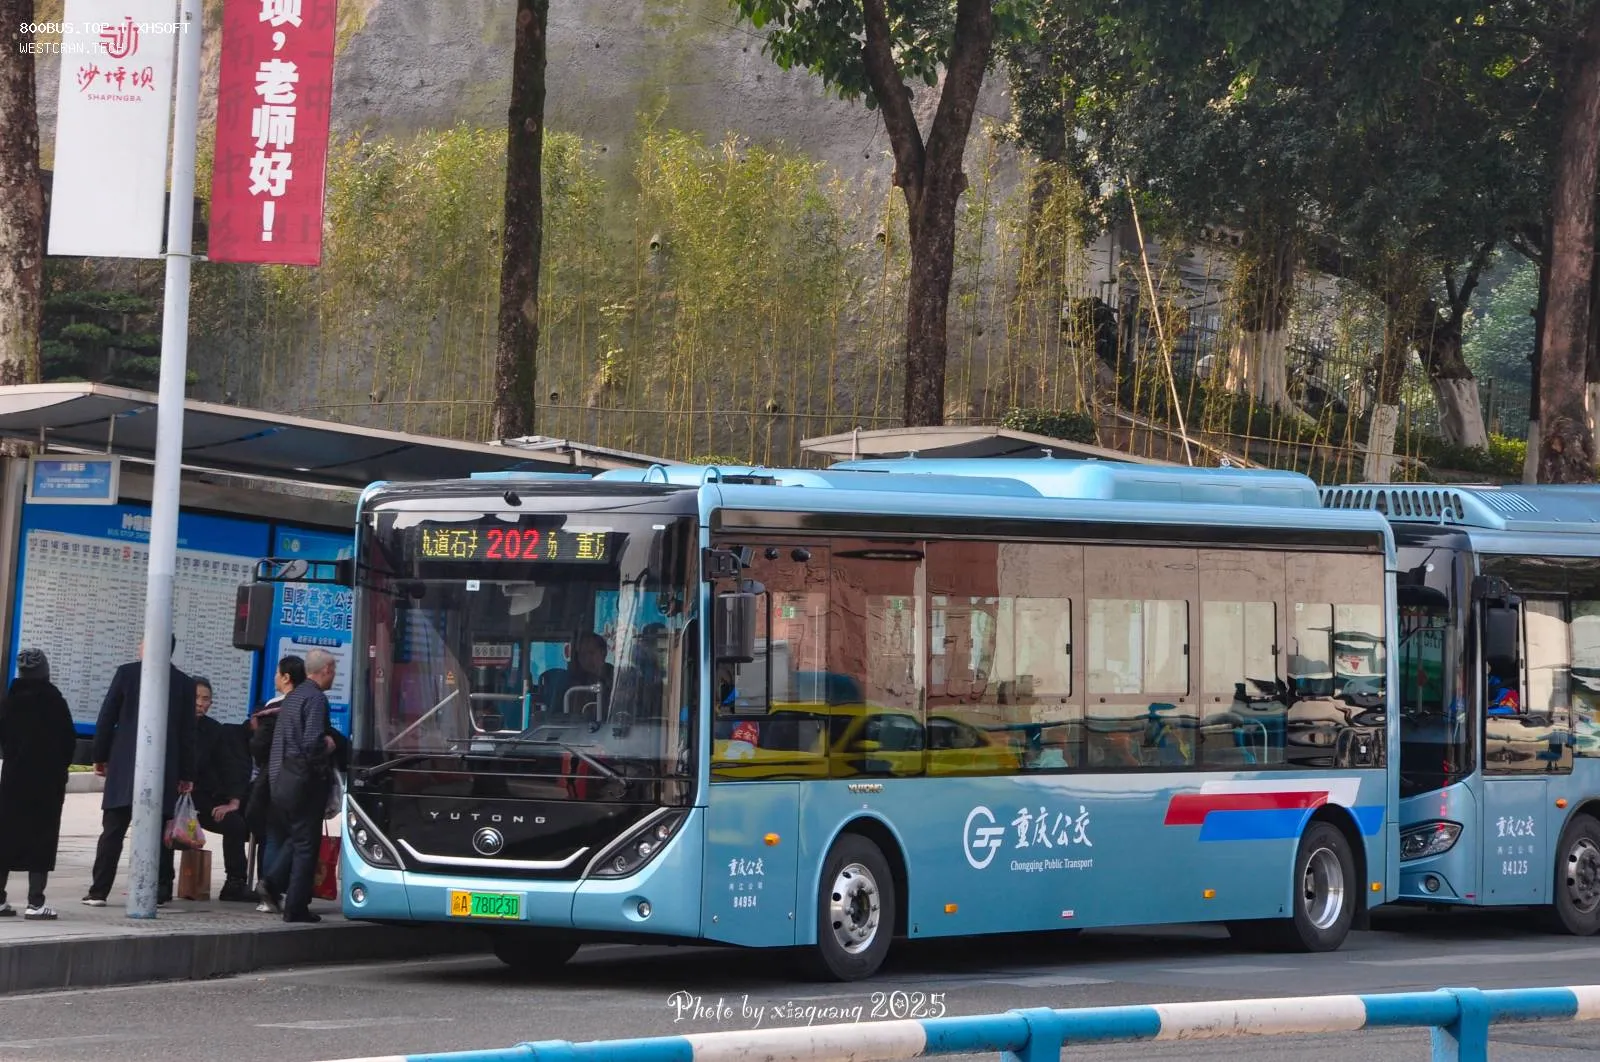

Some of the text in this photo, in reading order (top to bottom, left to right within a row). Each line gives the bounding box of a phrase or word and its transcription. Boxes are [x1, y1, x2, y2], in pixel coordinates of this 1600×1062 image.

[76, 62, 156, 92] 沙坪坝
[87, 94, 142, 102] SHAPINGBA
[486, 529, 541, 560] 202
[429, 811, 547, 824] YUTONG
[1010, 805, 1093, 850] 重庆公交
[1496, 815, 1535, 837] 重庆公交
[728, 857, 764, 877] 重庆公交
[1010, 858, 1093, 873] Chongqing Public Transport
[1502, 860, 1528, 875] 84125
